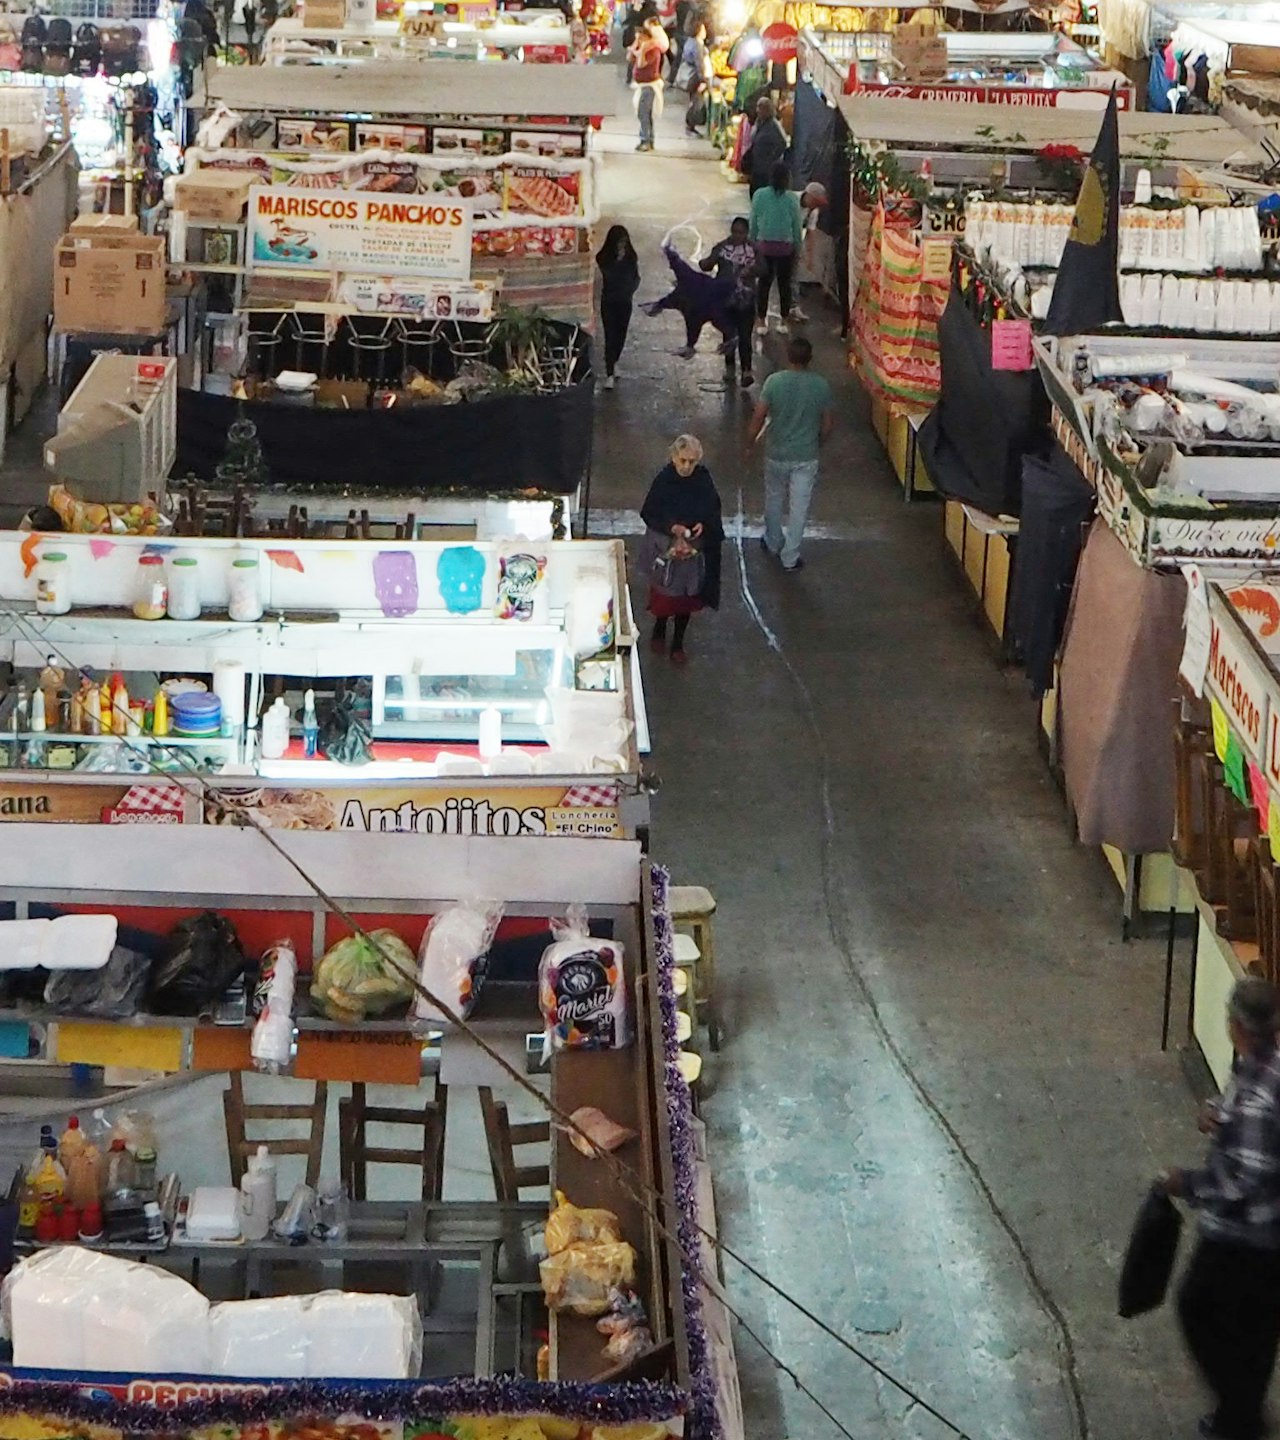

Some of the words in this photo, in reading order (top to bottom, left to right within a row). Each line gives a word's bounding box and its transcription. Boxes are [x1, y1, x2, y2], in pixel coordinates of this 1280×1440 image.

[258, 195, 358, 219] MARISCOS
[366, 202, 463, 226] PANCHO'S
[1209, 618, 1261, 745] Mariscos
[557, 985, 613, 1021] Mariel
[598, 1013, 613, 1025] 50
